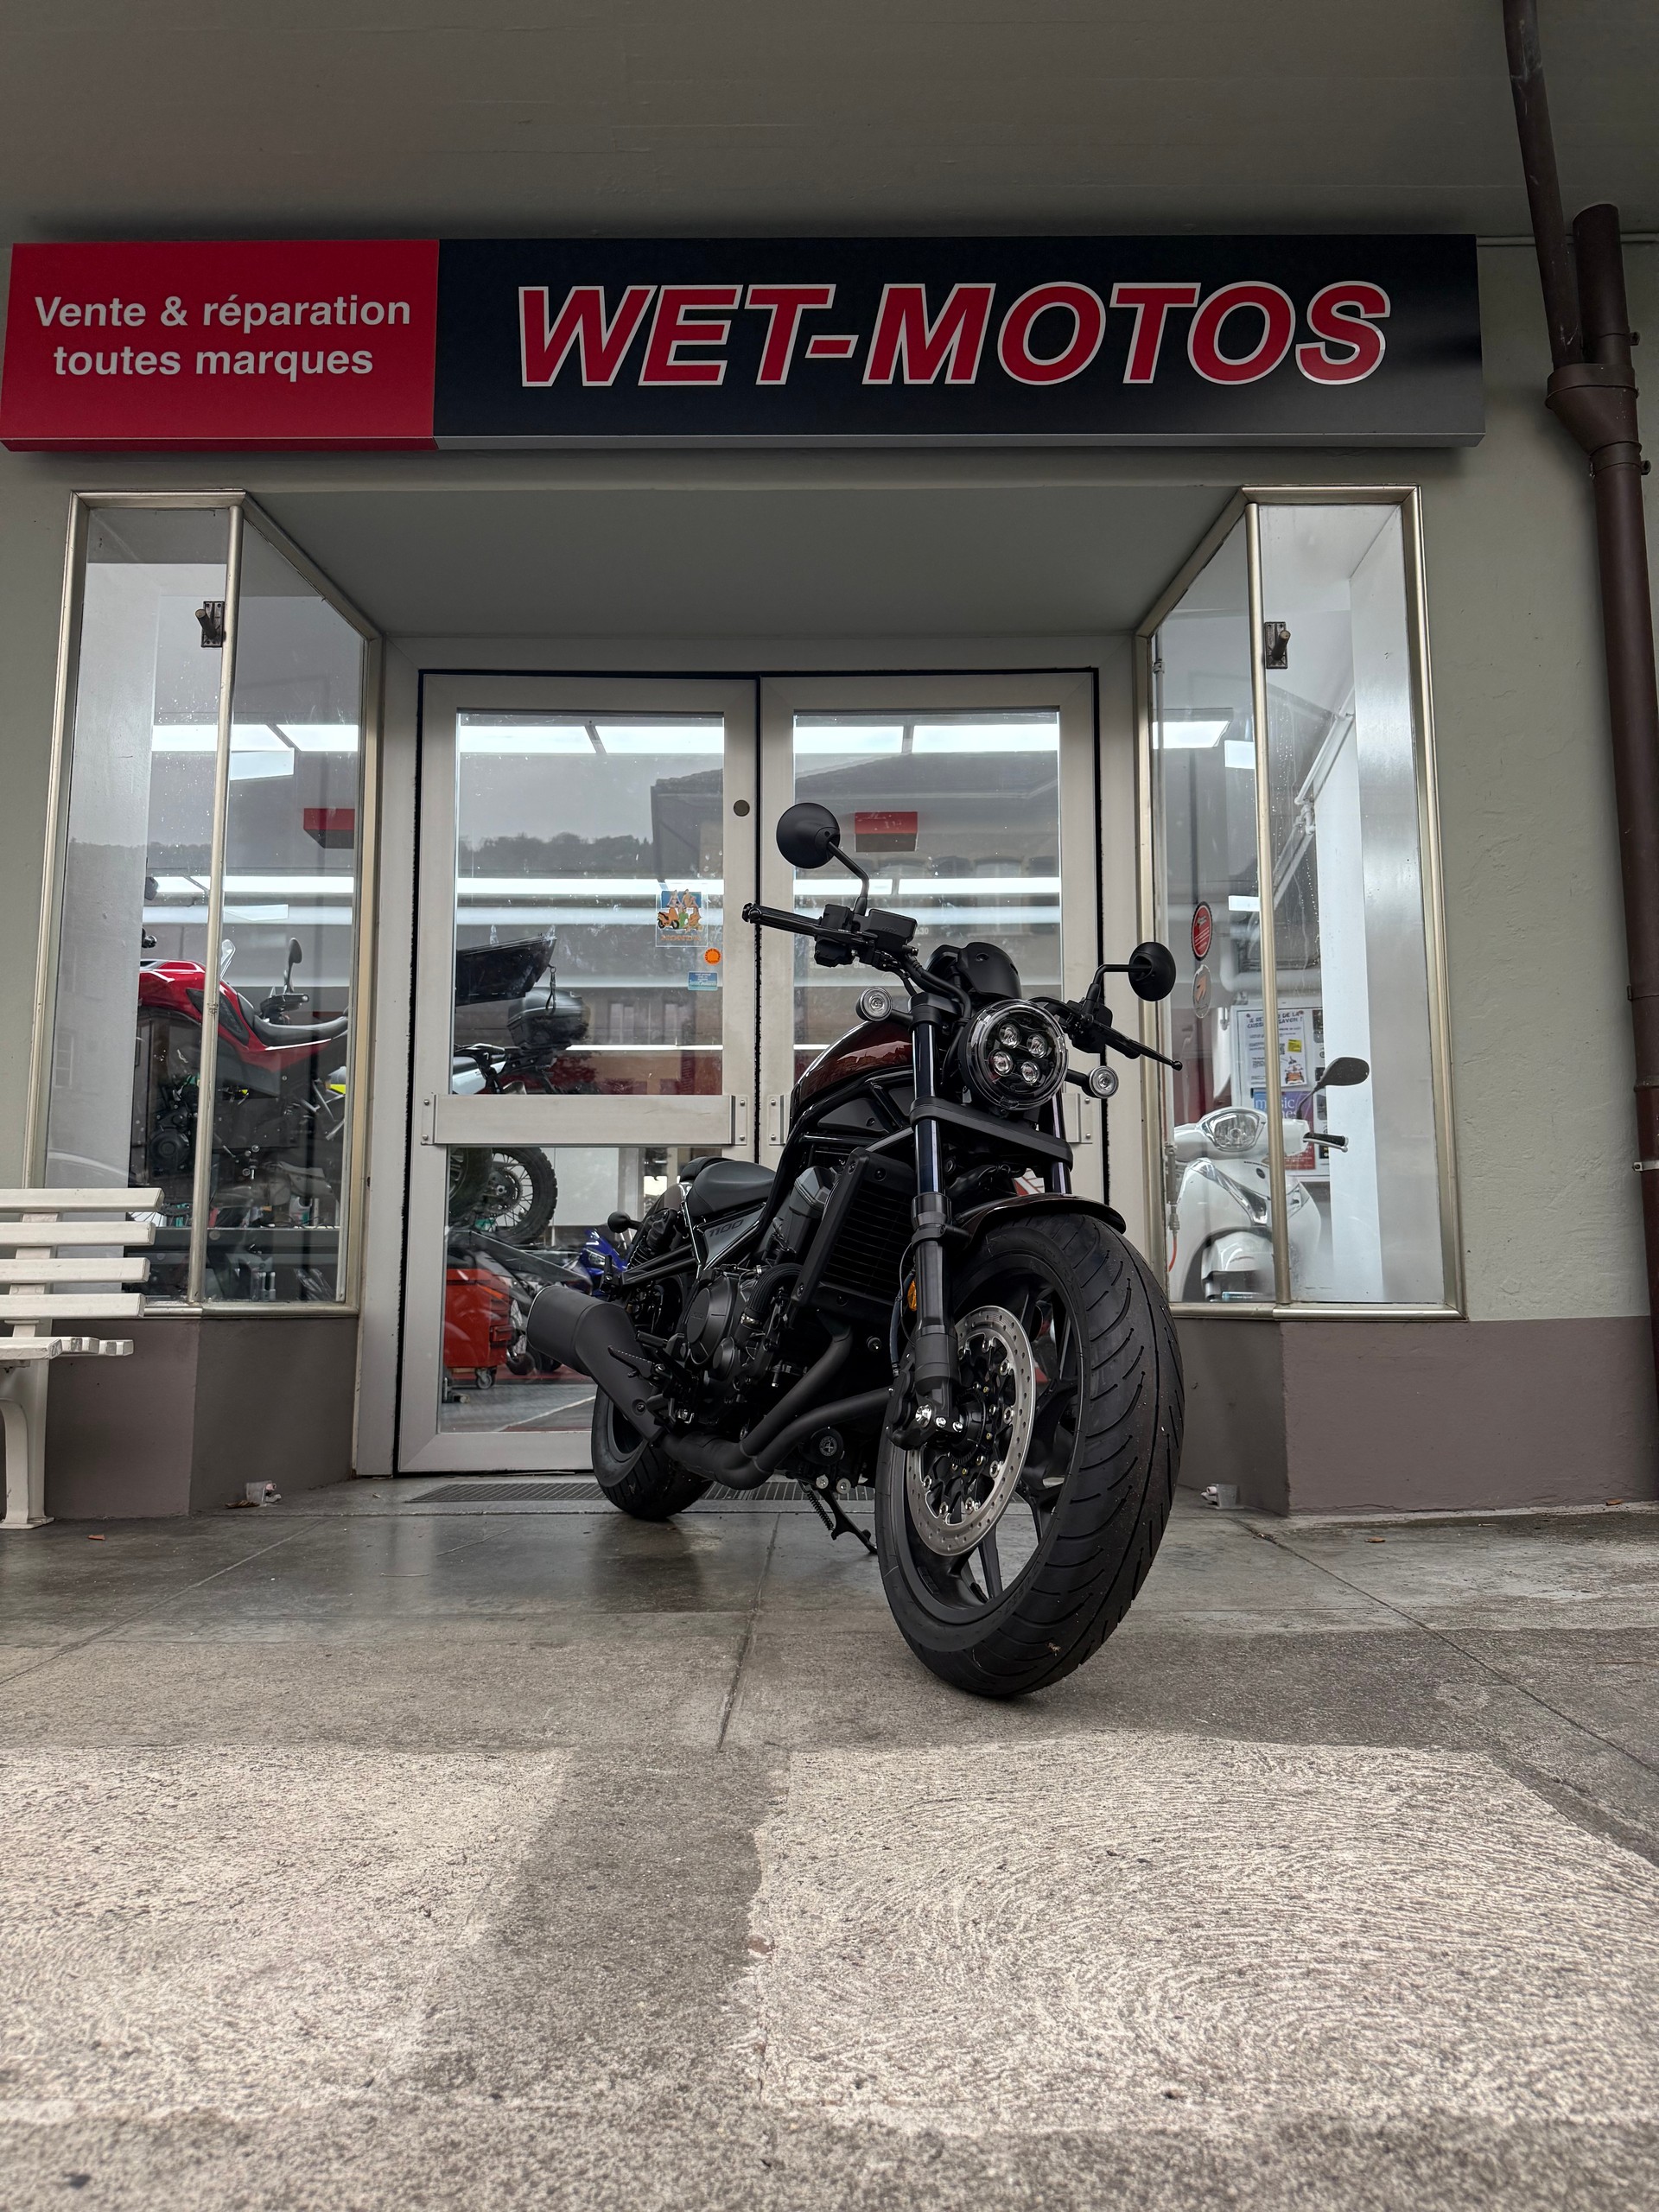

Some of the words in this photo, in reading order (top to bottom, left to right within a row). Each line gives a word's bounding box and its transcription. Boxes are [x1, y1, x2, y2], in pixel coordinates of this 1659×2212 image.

[35, 296, 146, 327] Vente
[162, 296, 188, 327] &
[204, 295, 410, 334] réparation
[518, 281, 1391, 387] WET-MOTOS
[54, 347, 181, 375] toutes
[197, 350, 373, 382] marques
[709, 1219, 744, 1237] 1100
